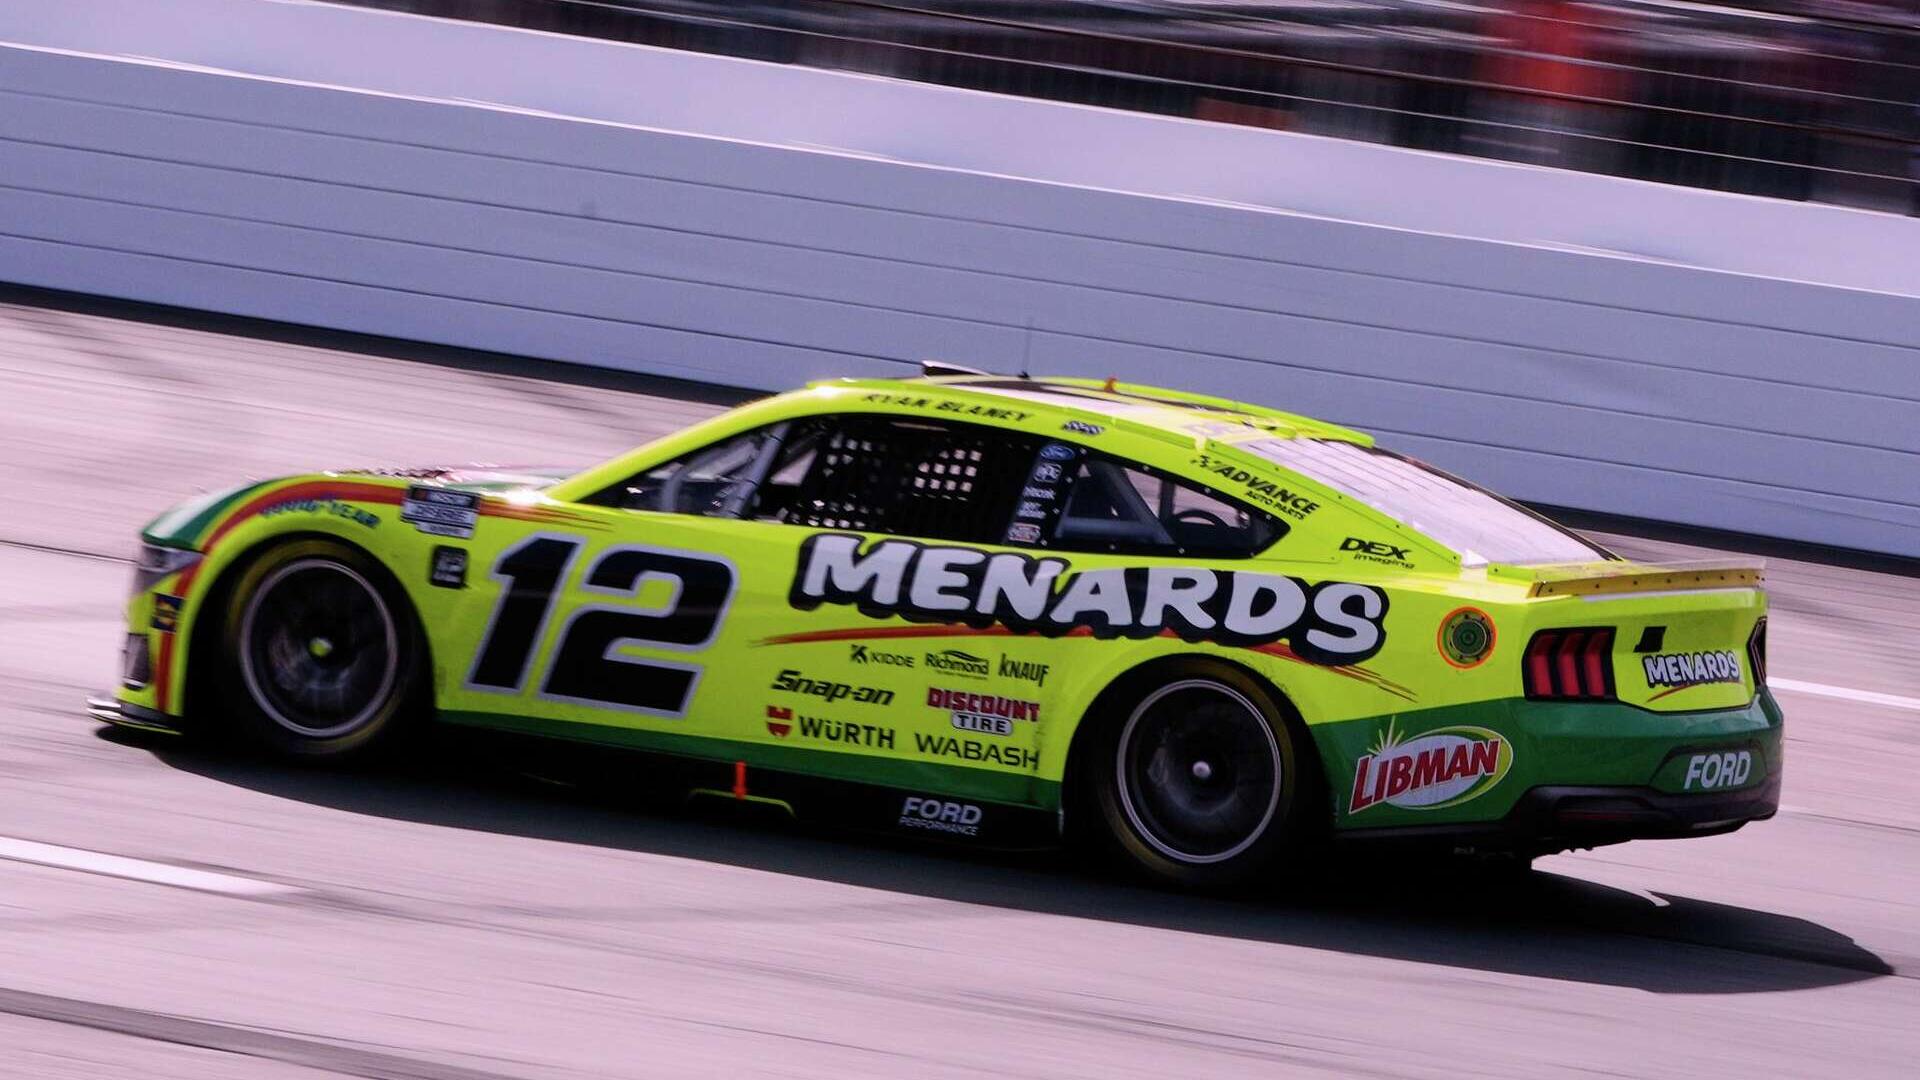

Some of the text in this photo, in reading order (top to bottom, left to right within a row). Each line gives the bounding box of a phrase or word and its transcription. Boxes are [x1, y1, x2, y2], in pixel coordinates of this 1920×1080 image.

[936, 400, 1034, 423] BLANEY
[1216, 463, 1319, 514] ADVANCE
[1245, 490, 1305, 521] AUTO PARTS
[1339, 537, 1412, 560] DEX
[1353, 553, 1416, 570] imaging
[795, 533, 1388, 661] MENARDS
[466, 533, 738, 716] 12
[871, 652, 915, 668] KIDDE
[925, 652, 989, 675] Richmond
[998, 653, 1050, 687] KNAUF
[1643, 651, 1740, 687] MENARDS
[771, 669, 895, 706] Snap-on
[927, 687, 1041, 722] DISCOUNT
[957, 714, 1008, 734] TIRE
[914, 732, 1041, 771] WABASH
[1349, 739, 1502, 814] LIBMAN
[1684, 751, 1752, 790] FORD
[899, 816, 980, 837] PERFORMANCE
[903, 798, 982, 824] FORD
